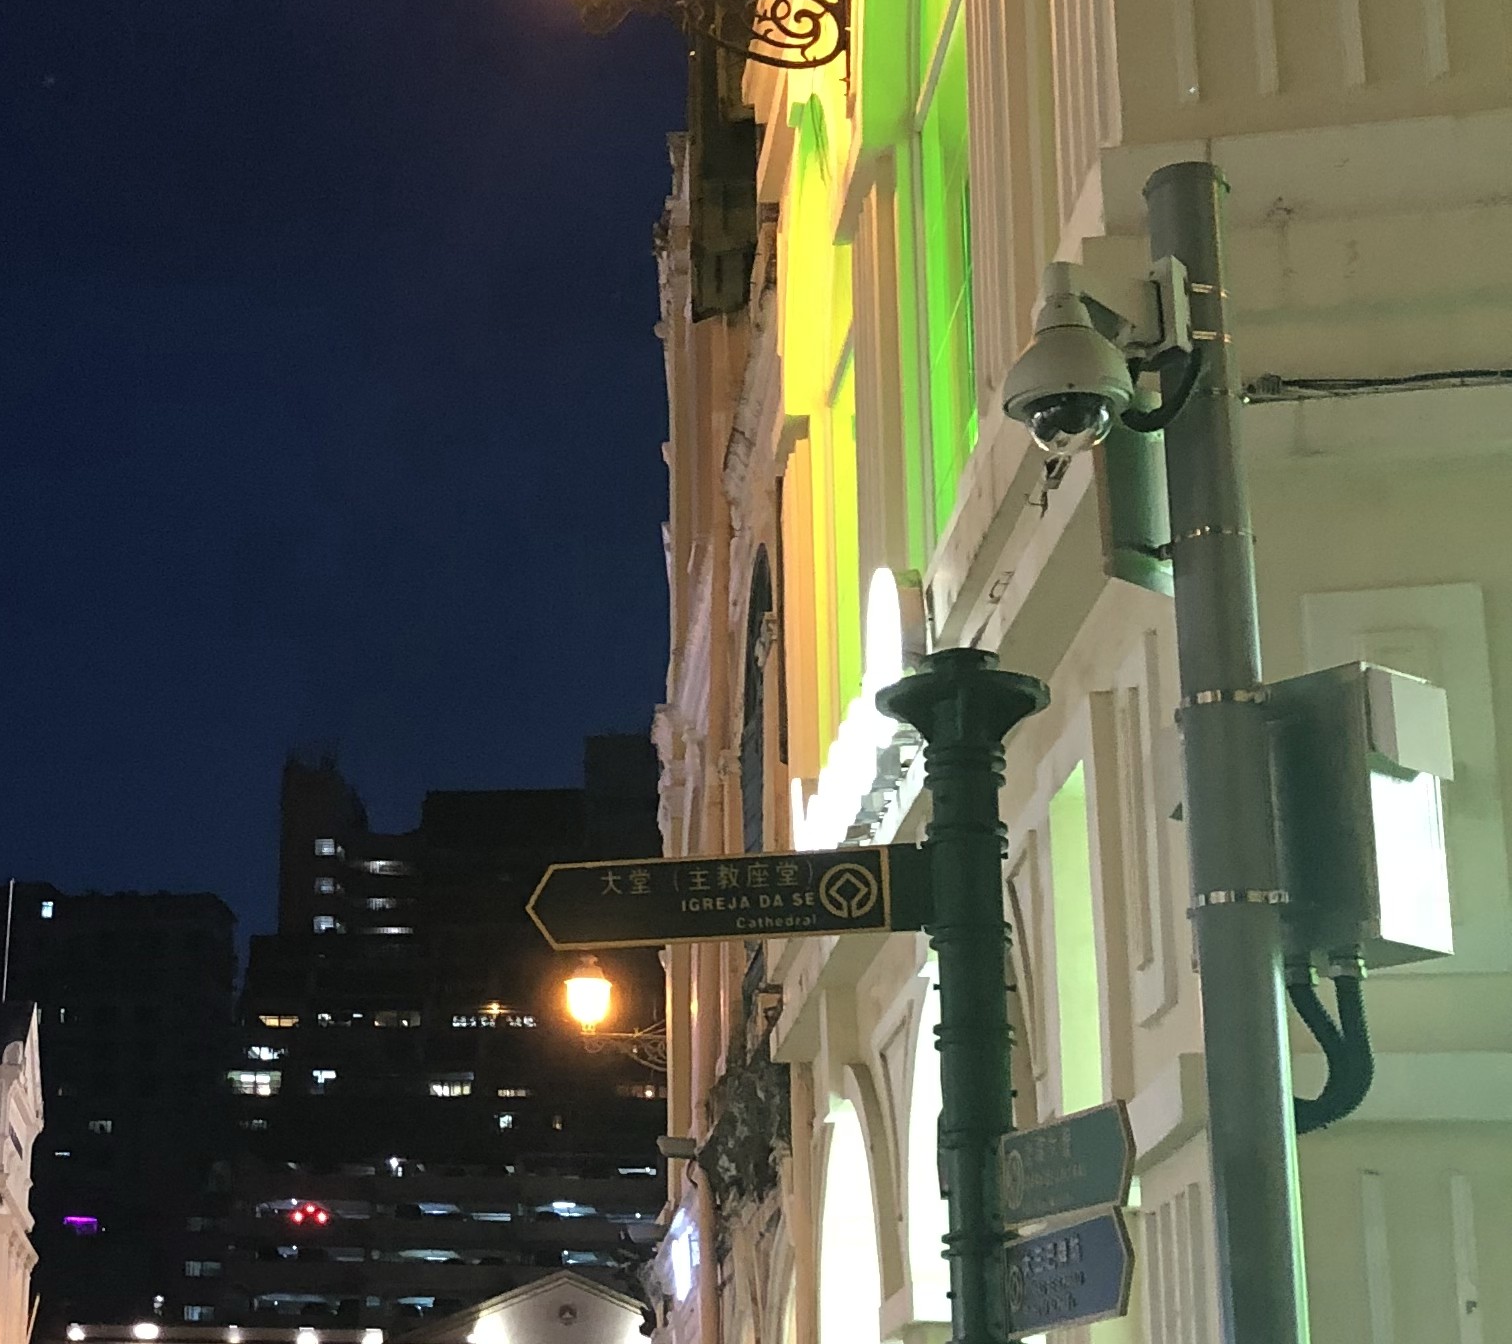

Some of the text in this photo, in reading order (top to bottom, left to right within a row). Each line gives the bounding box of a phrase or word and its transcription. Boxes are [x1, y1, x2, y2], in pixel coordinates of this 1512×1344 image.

[681, 895, 751, 912] IGREJA
[759, 893, 784, 909] DA
[736, 913, 817, 929] Cathedral
